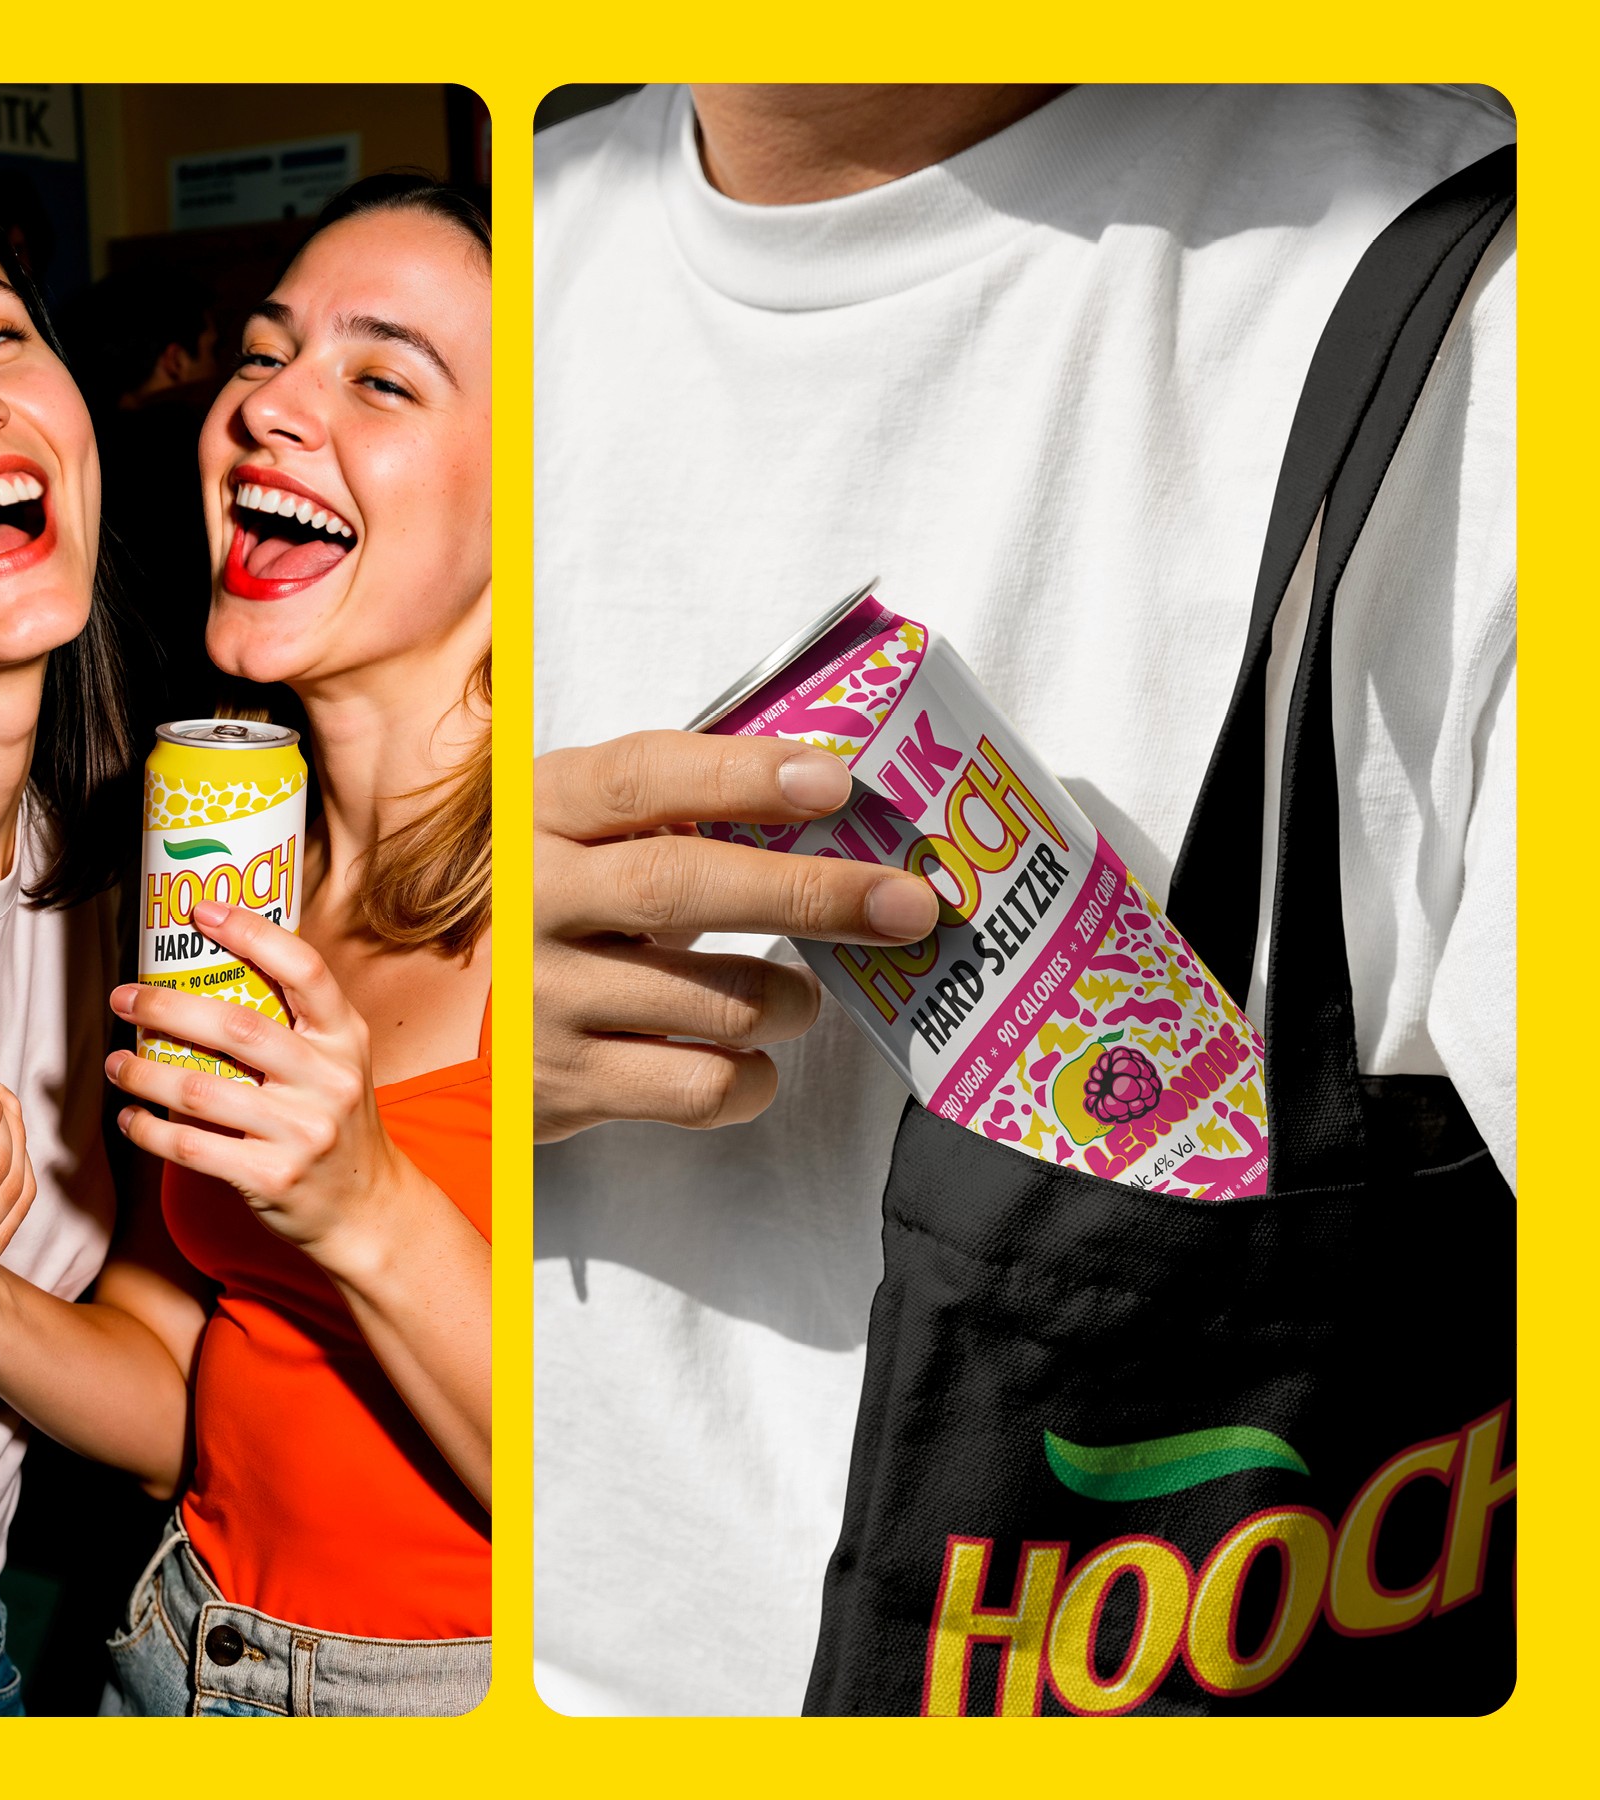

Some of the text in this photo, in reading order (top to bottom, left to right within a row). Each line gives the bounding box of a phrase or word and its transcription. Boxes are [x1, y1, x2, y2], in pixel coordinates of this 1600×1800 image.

[762, 699, 790, 724] WATER
[795, 655, 845, 698] REFRESHINGLY
[146, 833, 296, 929] HOOCH
[155, 932, 204, 962] HARD
[190, 976, 200, 988] 90
[203, 966, 246, 985] CALORIES
[910, 842, 1070, 1055] HARD SELTZER
[939, 864, 1118, 1122] ZERO SUGAR 90 CALORIES ZERO CARBS
[1083, 1022, 1251, 1180] LEMONADE
[1129, 1134, 1196, 1190] Alc 4% Vol
